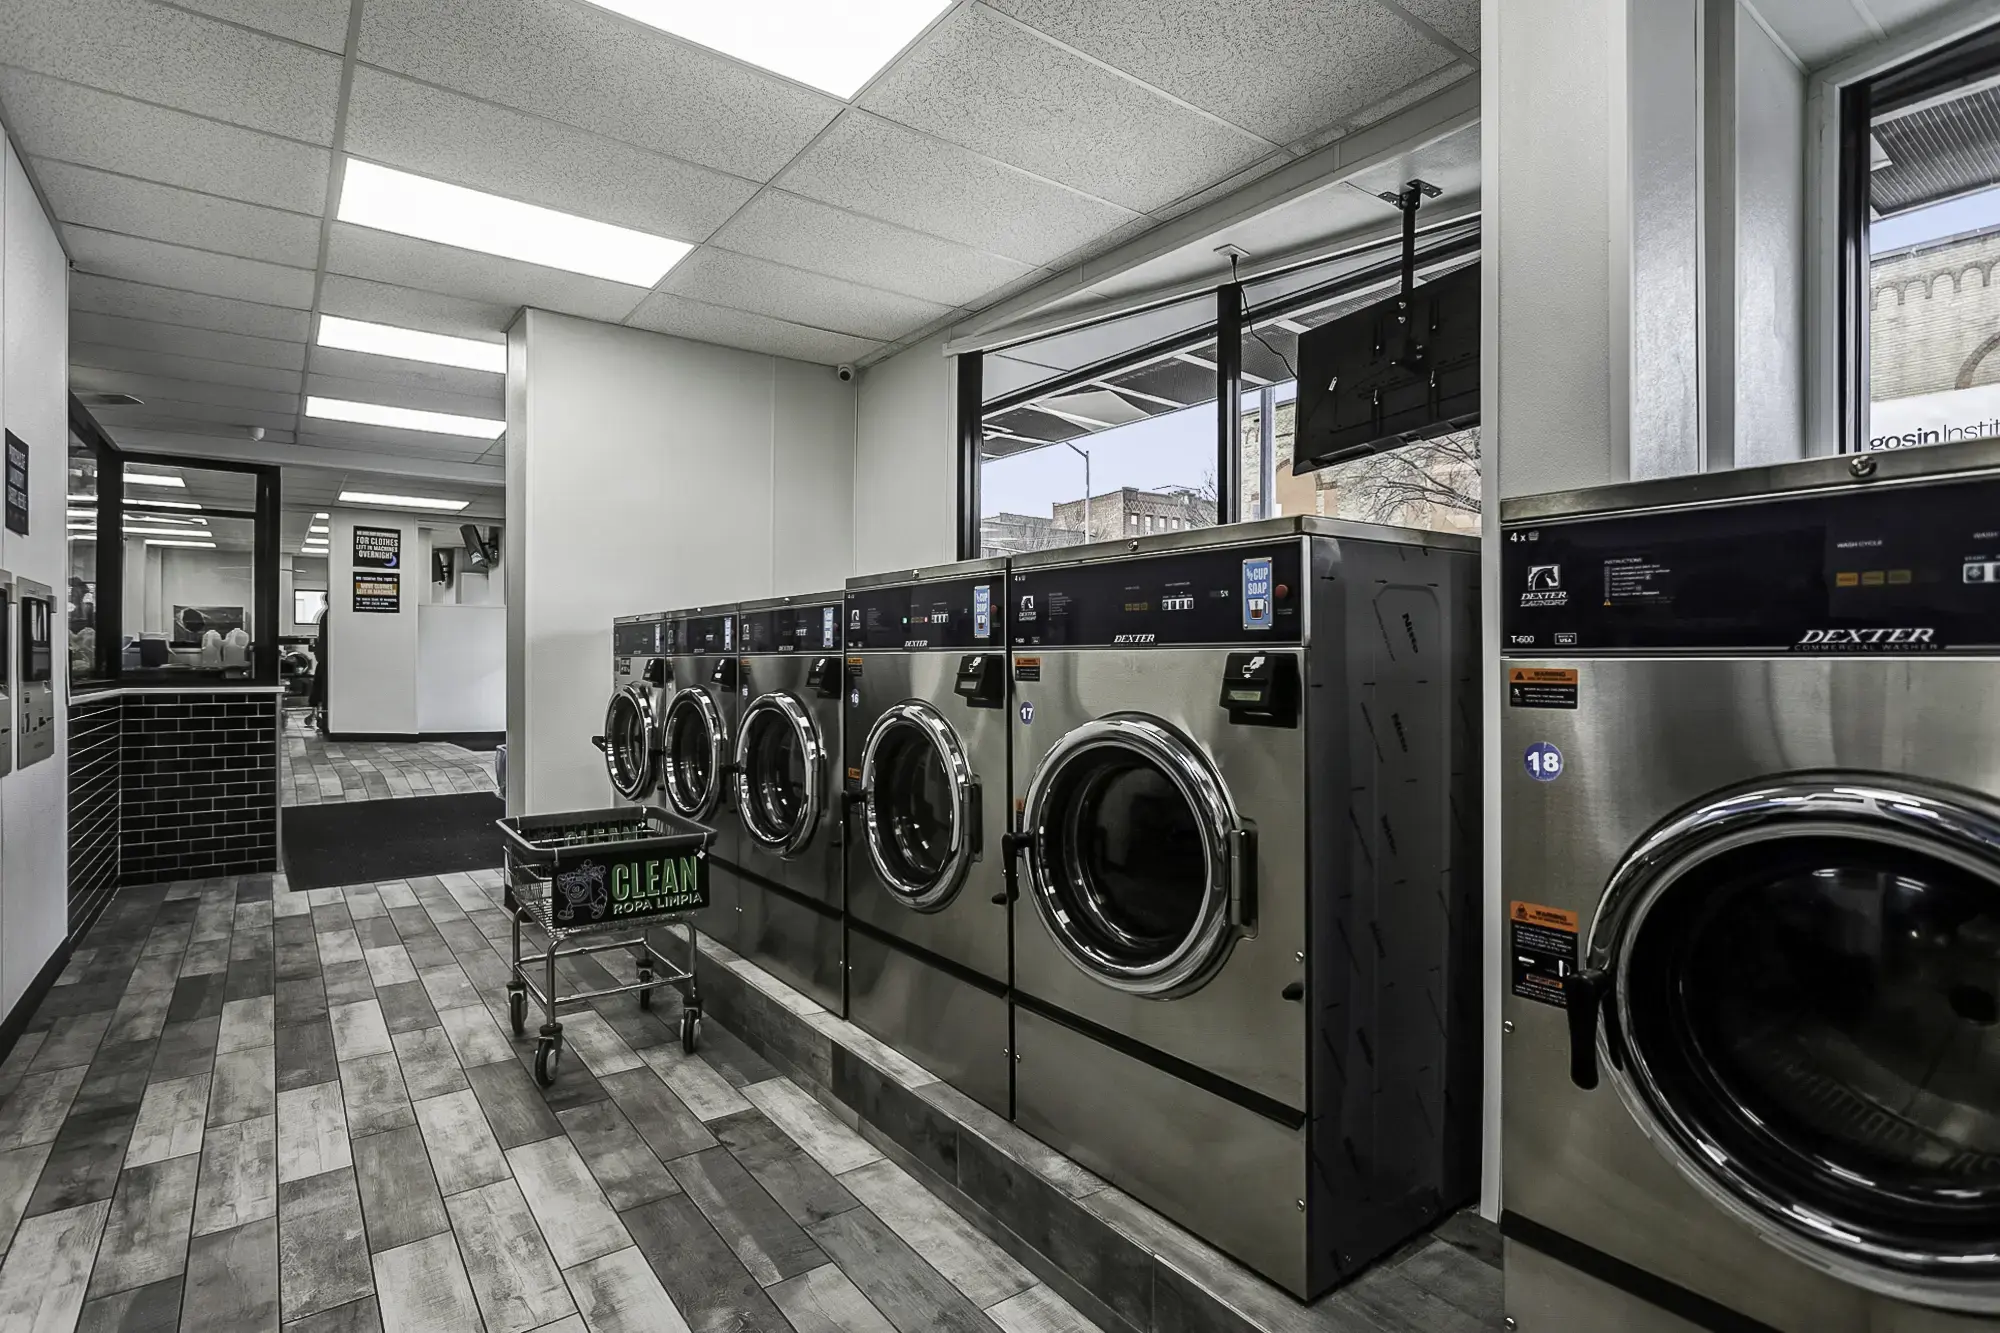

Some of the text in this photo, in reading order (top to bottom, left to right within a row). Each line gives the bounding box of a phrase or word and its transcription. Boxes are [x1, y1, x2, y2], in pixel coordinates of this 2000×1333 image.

[356, 536, 398, 547] FOR CLOTHES
[1510, 532, 1518, 543] 4
[358, 550, 393, 560] OVERNIGHT
[1247, 581, 1268, 595] SOAP
[1520, 591, 1567, 600] DEXTER
[1520, 599, 1568, 607] LAUNDRY
[1113, 633, 1155, 643] DEXTER
[1511, 635, 1535, 644] T-600
[1798, 628, 1935, 644] DEXTER
[1794, 643, 1938, 651] COMMERCIAL WASHER
[851, 692, 859, 703] 16
[1021, 707, 1034, 720] 17
[1527, 752, 1559, 772] 18
[611, 855, 698, 901] CLEAN
[613, 892, 704, 915] ROPA LIMPIA
